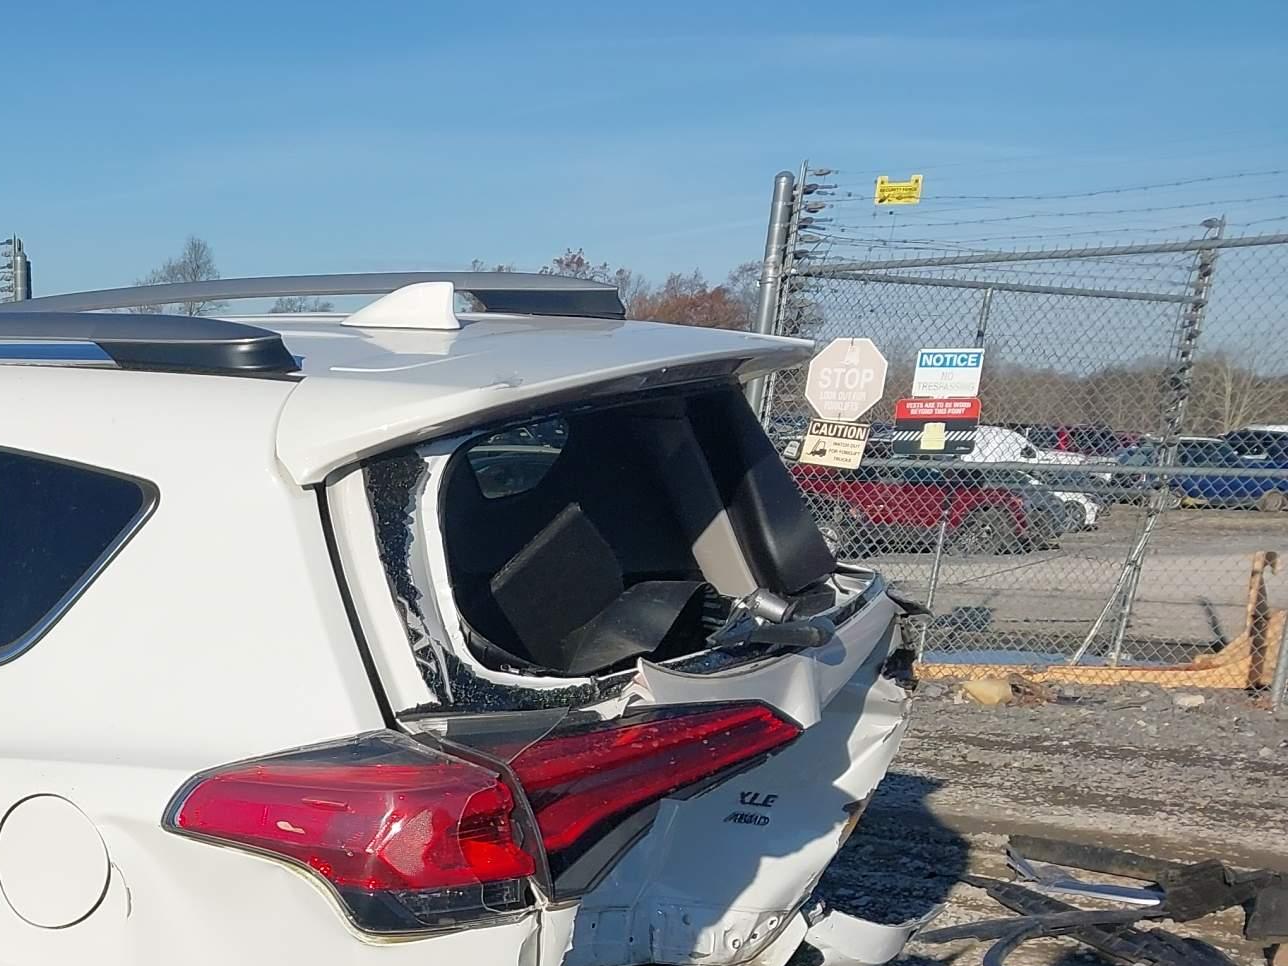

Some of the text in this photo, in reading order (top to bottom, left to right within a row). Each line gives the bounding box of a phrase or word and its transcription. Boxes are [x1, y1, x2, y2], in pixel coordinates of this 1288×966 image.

[921, 353, 978, 366] NOTICE
[819, 367, 874, 389] STOP
[940, 371, 954, 381] NO
[838, 391, 852, 400] OUT
[811, 422, 867, 440] CAUTION
